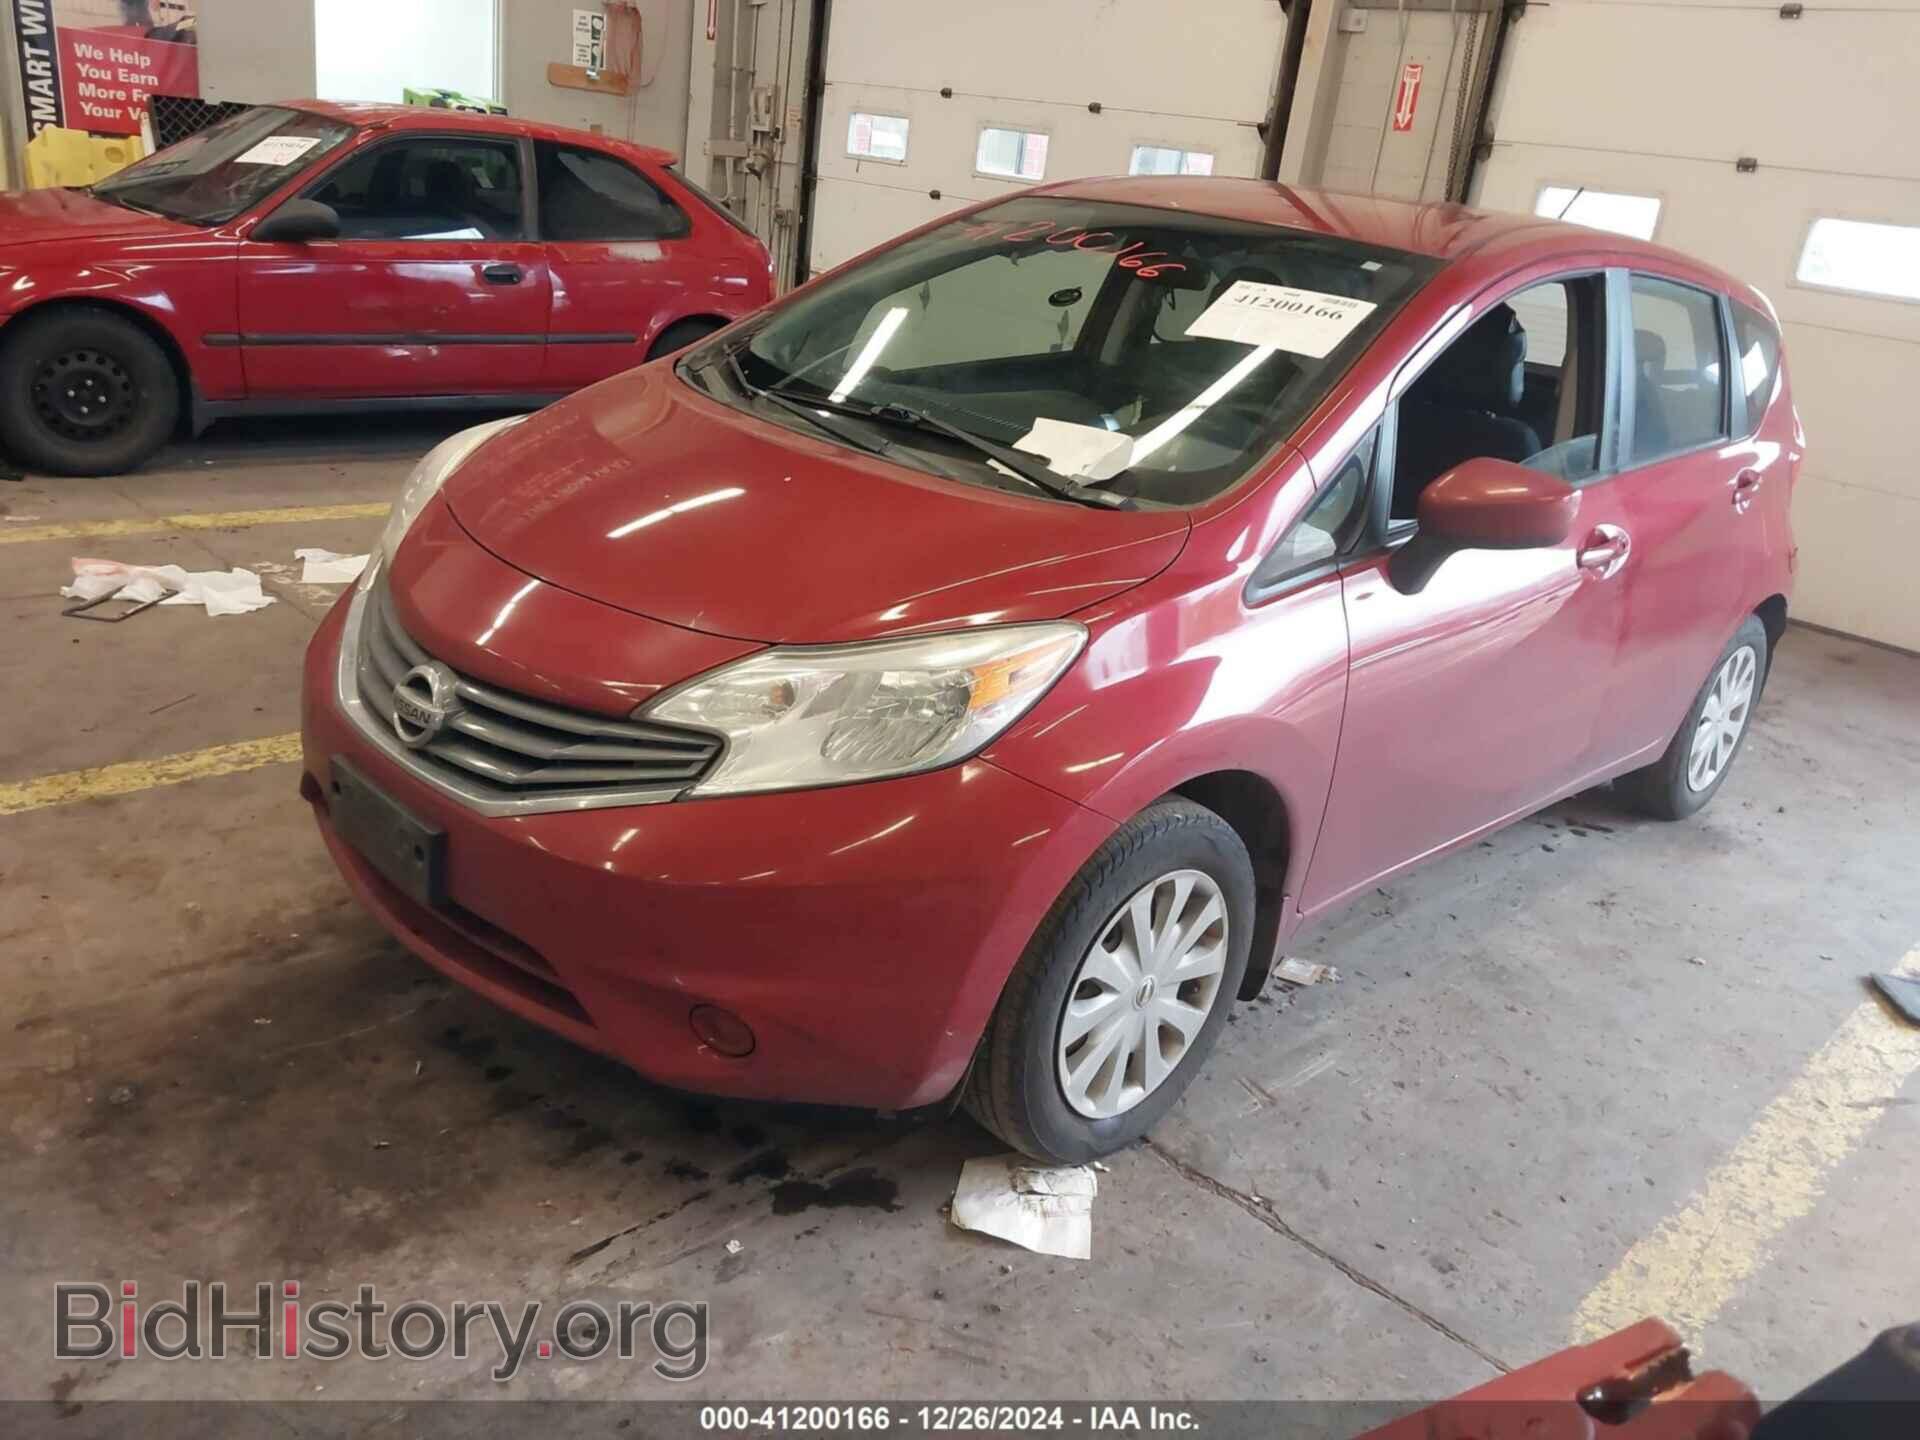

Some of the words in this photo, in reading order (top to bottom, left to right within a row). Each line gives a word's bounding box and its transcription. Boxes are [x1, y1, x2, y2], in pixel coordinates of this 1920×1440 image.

[73, 42, 104, 61] We
[109, 47, 151, 69] Help
[76, 62, 112, 81] You
[117, 67, 159, 87] Earn
[78, 81, 127, 101] More
[80, 101, 122, 119] Your
